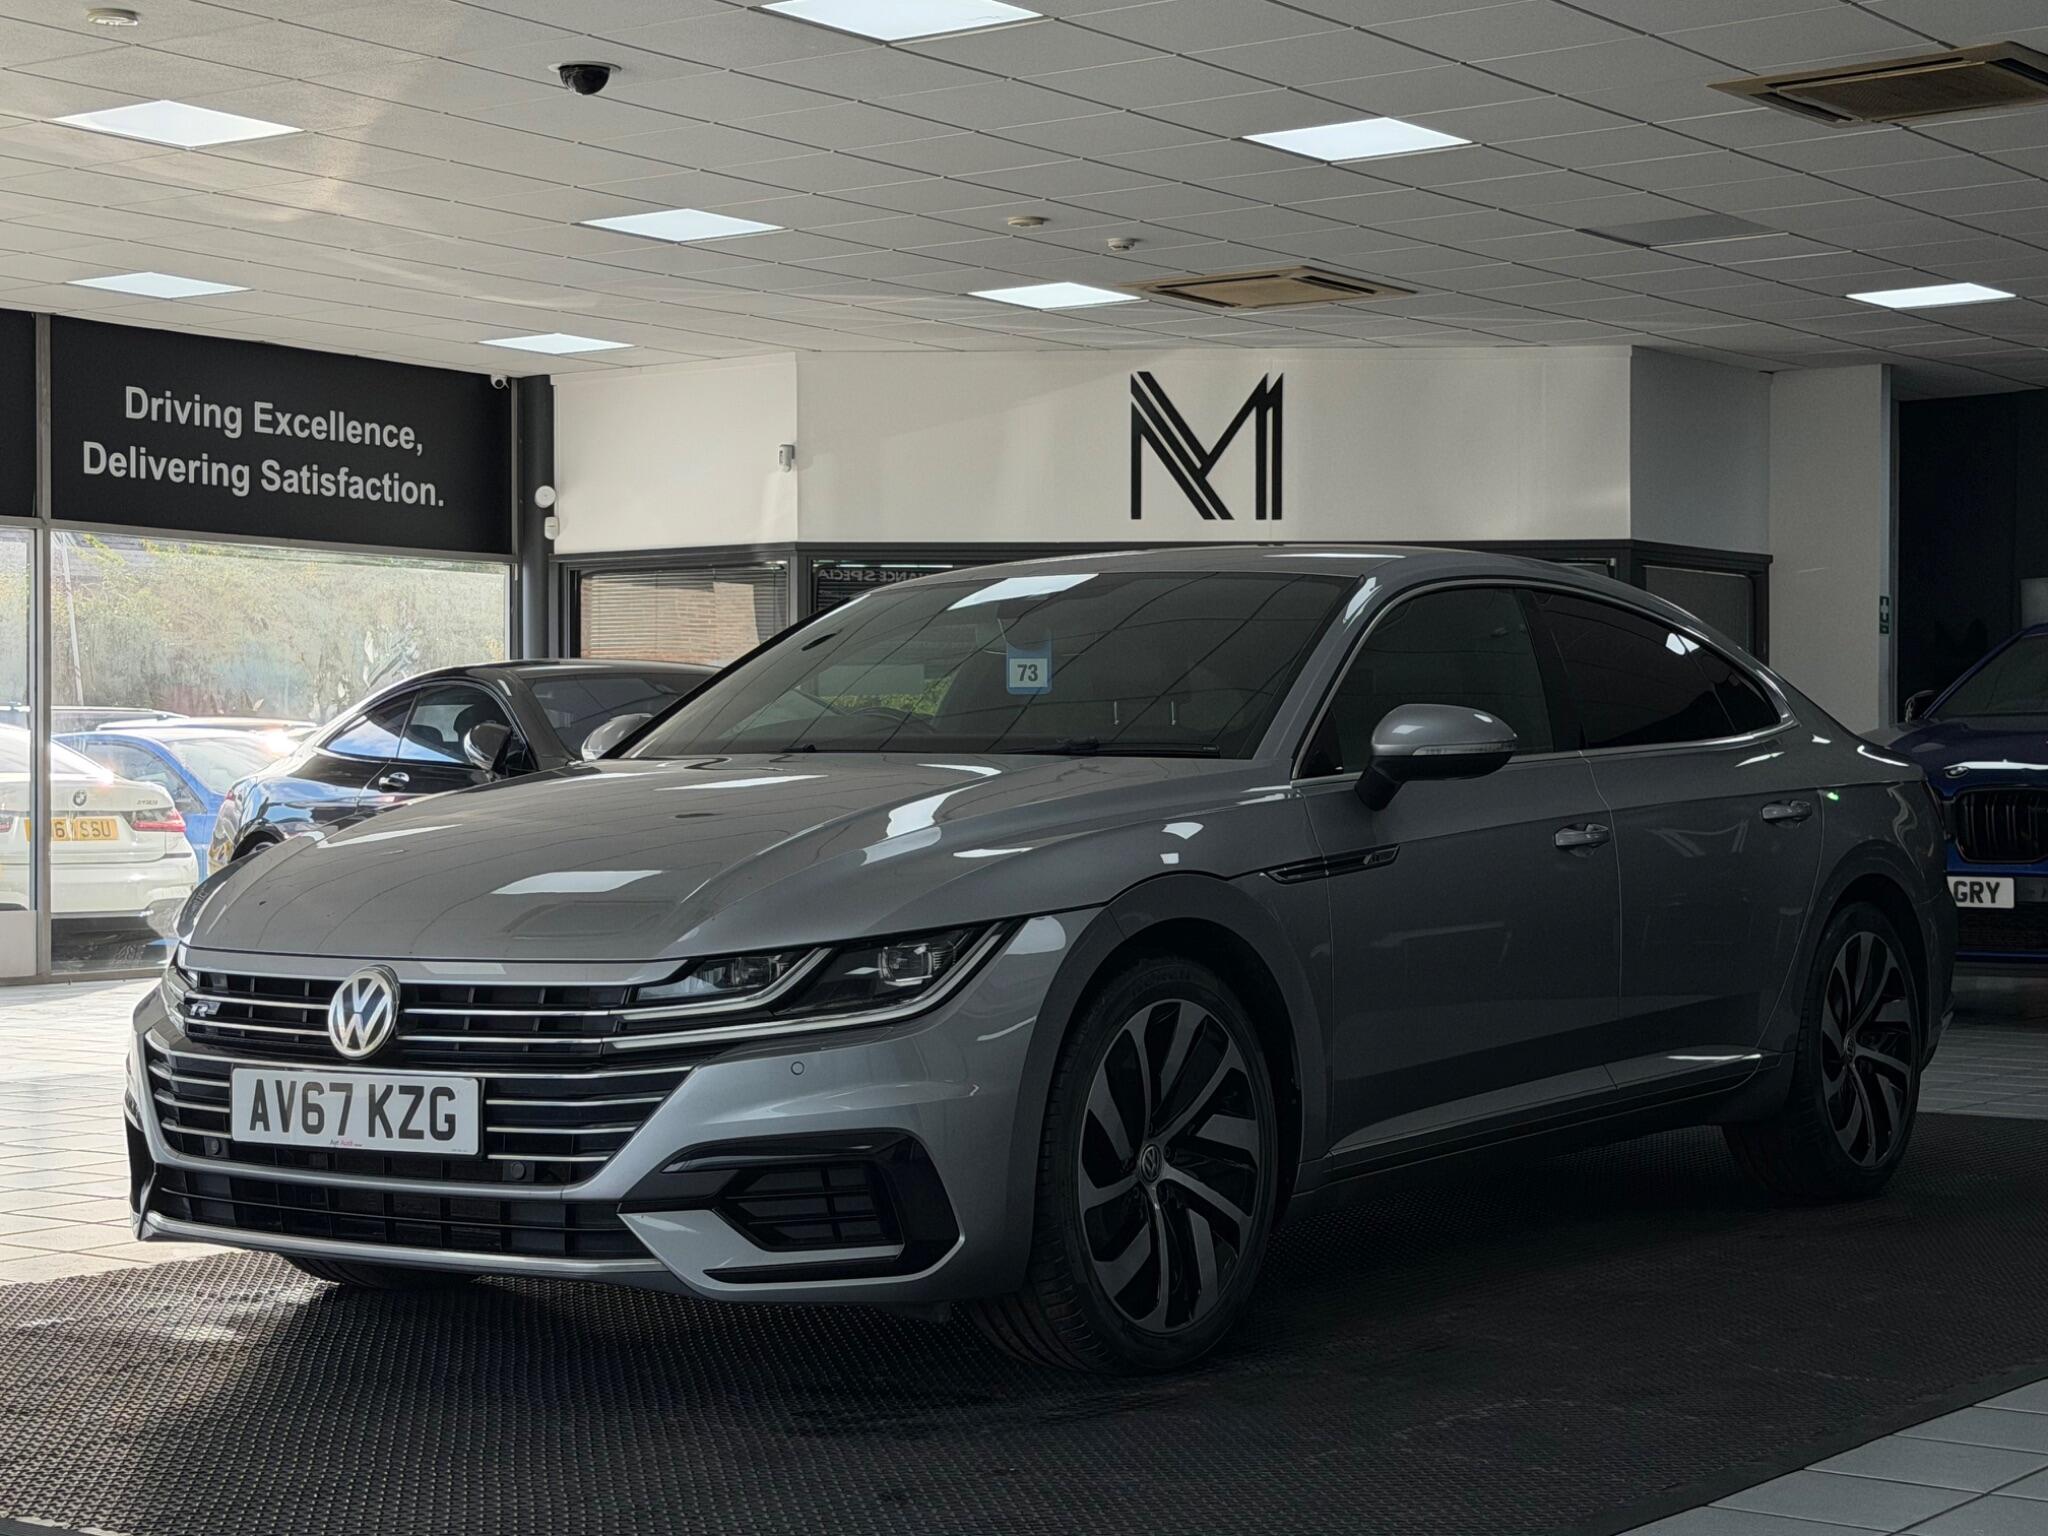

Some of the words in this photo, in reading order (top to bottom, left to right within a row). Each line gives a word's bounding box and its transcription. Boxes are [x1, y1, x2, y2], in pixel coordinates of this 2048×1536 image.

[125, 386, 242, 439] Driving
[254, 401, 424, 456] Excellence,
[83, 441, 250, 497] Delivering
[261, 459, 445, 507] Satisfaction.
[1017, 664, 1039, 682] 73
[1953, 880, 2001, 904] GRY
[330, 970, 397, 1058] VW
[249, 1078, 354, 1137] AV67
[368, 1083, 456, 1141] KZG
